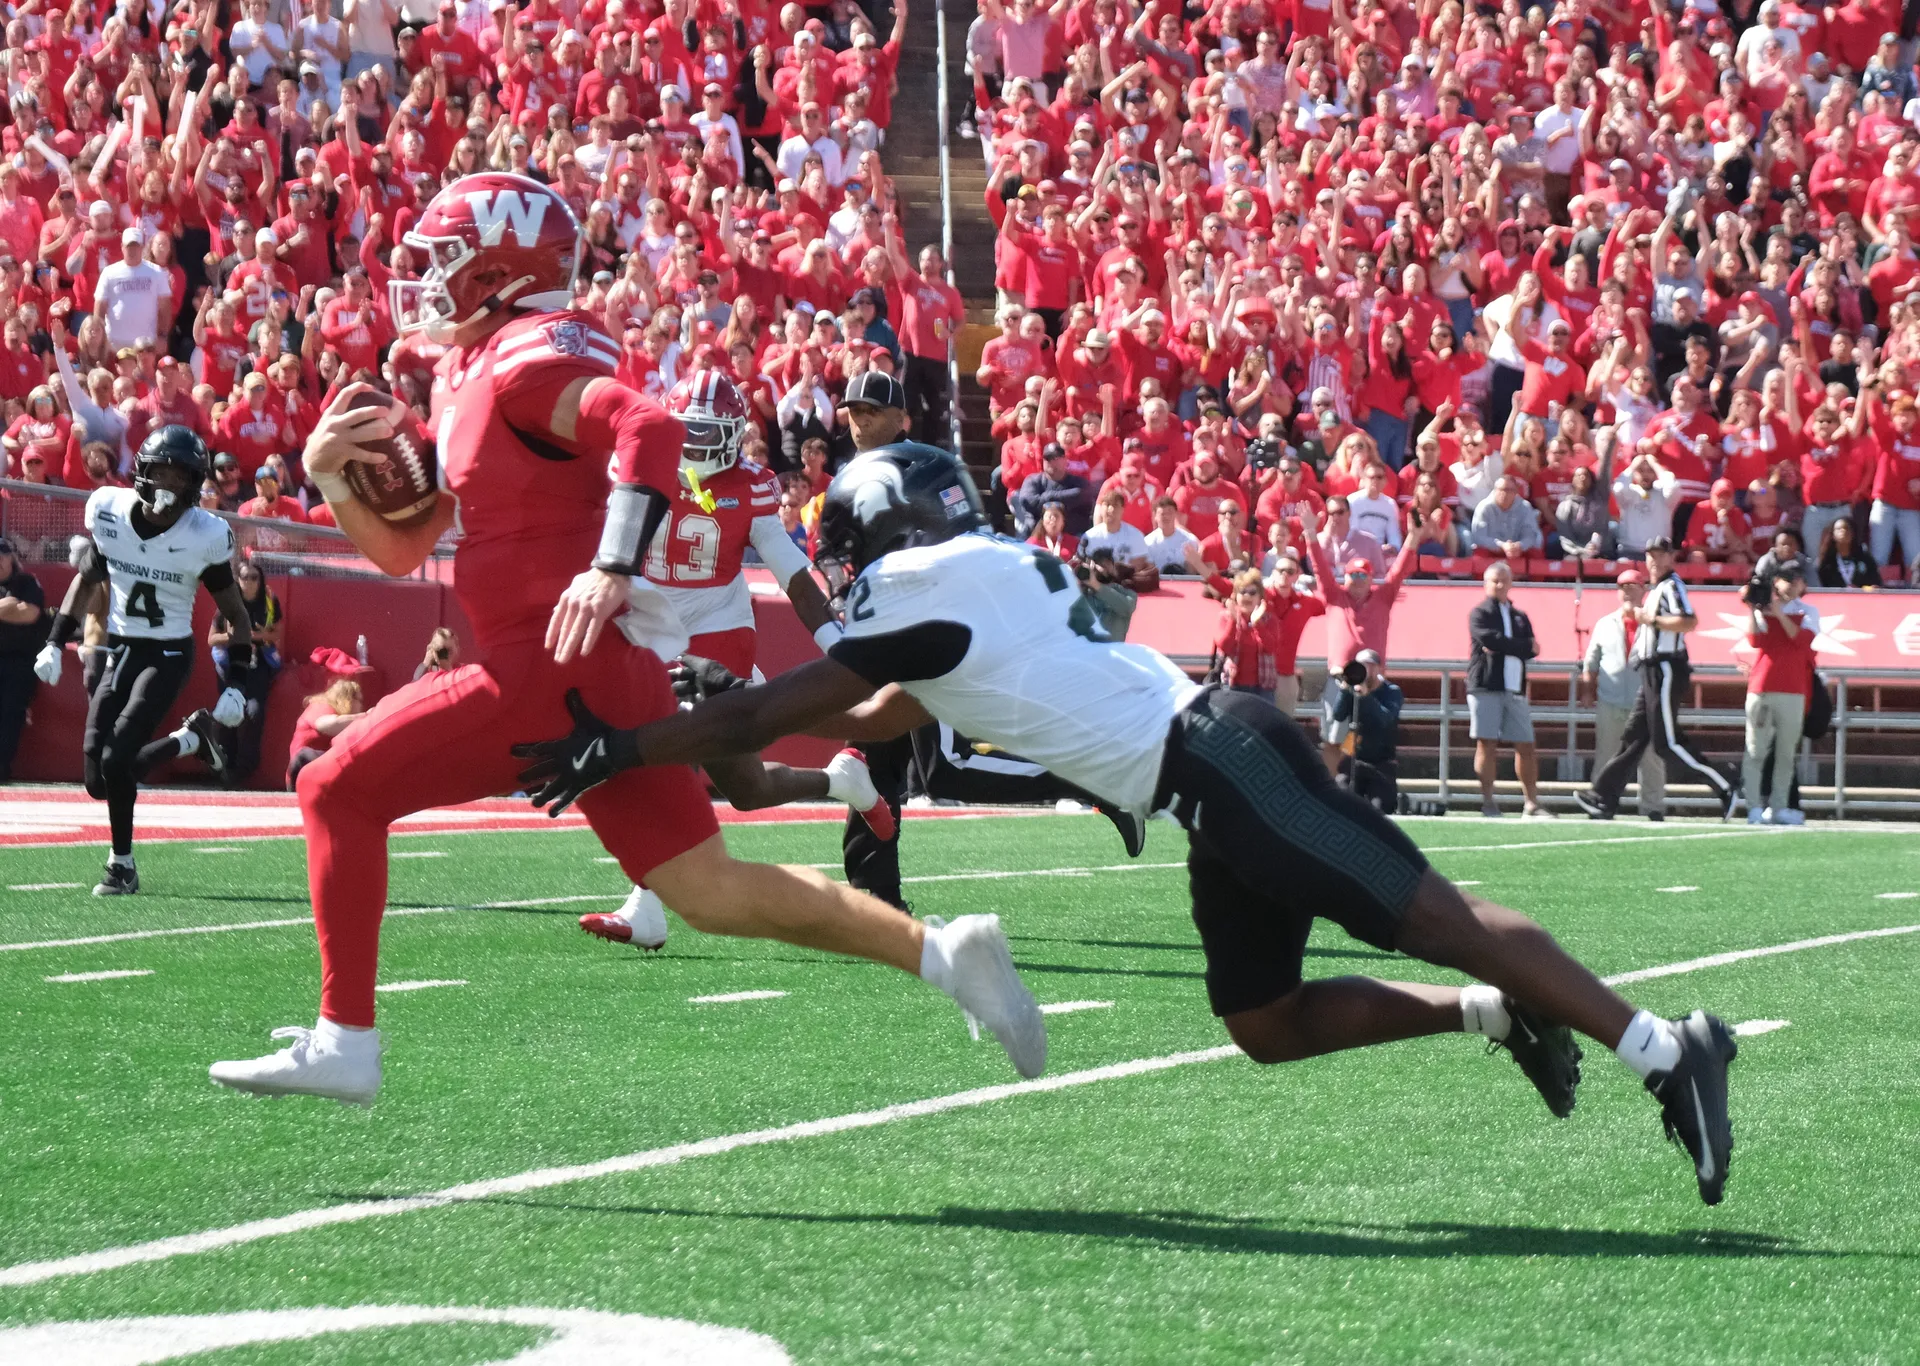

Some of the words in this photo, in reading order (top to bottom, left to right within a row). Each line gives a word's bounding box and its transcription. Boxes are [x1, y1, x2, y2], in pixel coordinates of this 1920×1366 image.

[465, 190, 552, 248] W
[239, 421, 278, 438] WISCSIN
[644, 509, 721, 582] 13
[106, 556, 150, 578] MICHIGAN
[151, 569, 185, 585] STATE
[125, 580, 165, 628] 4
[850, 576, 875, 622] 2
